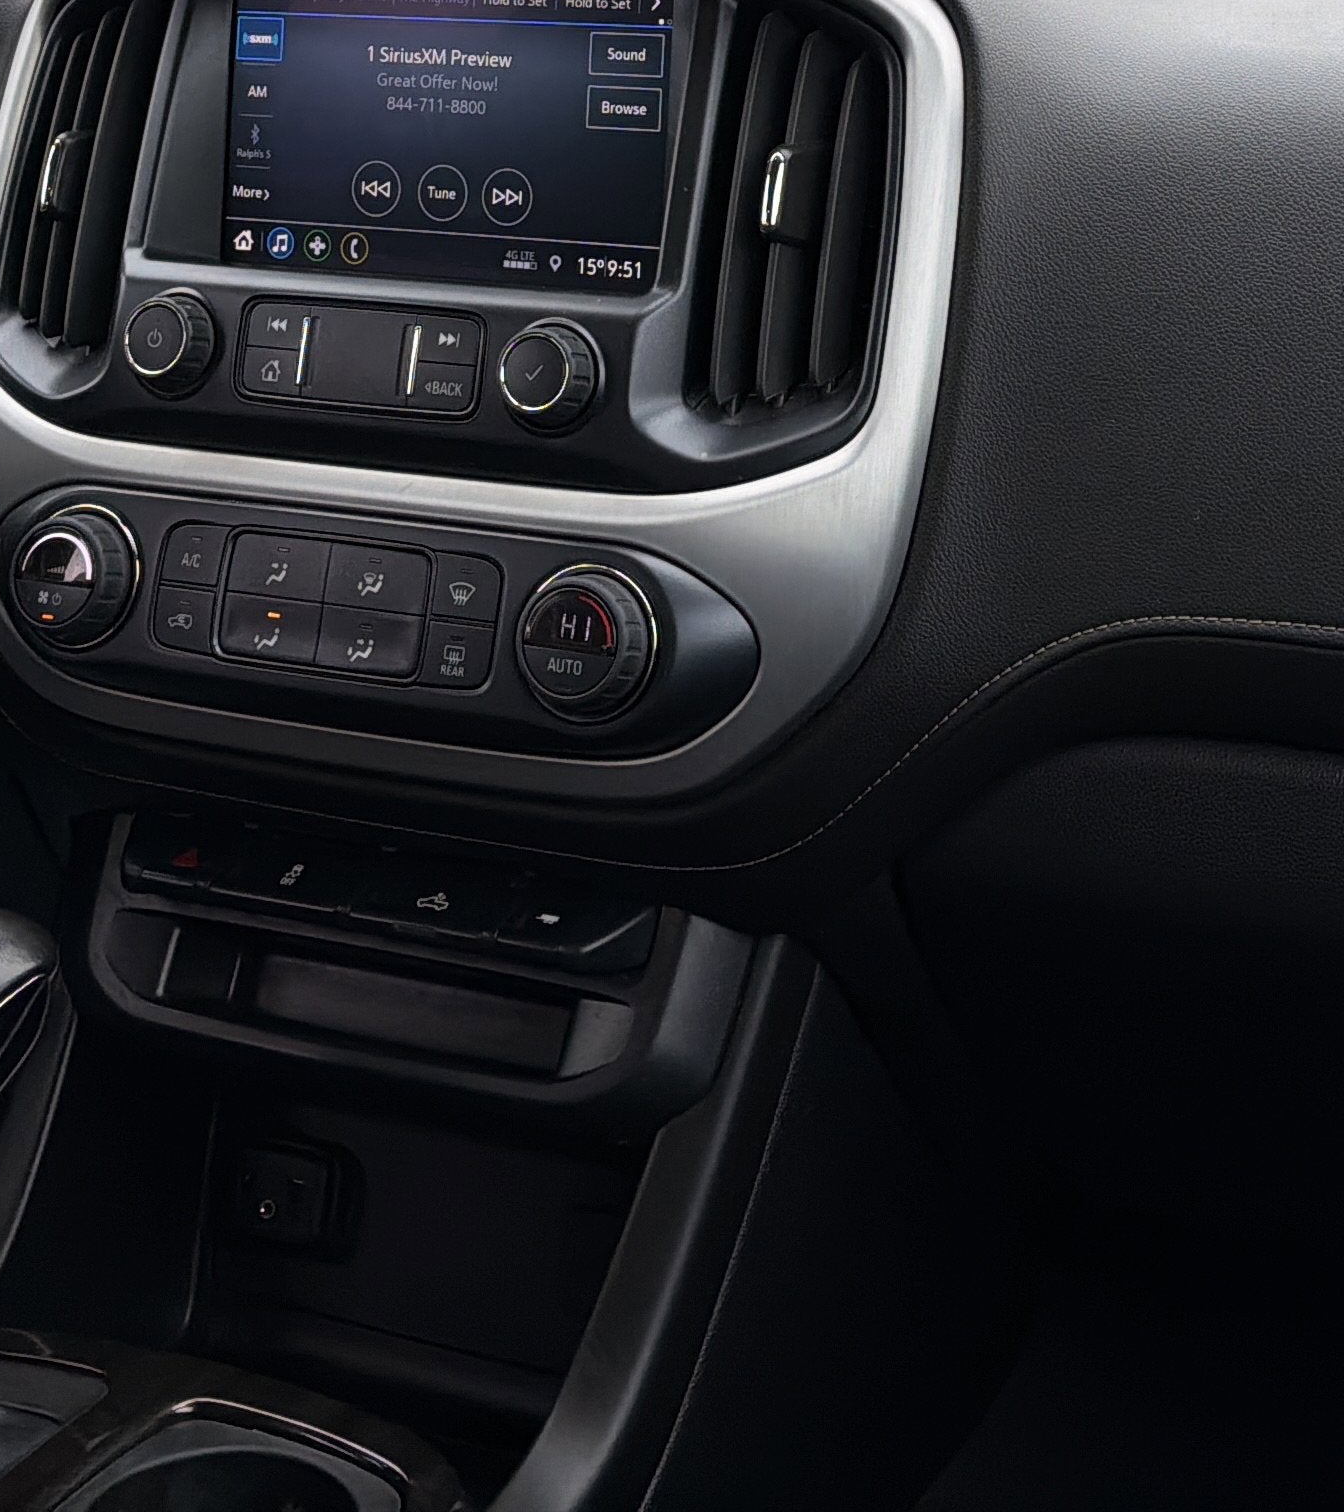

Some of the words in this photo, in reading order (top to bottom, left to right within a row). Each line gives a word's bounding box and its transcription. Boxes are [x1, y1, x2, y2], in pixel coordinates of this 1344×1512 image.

[367, 45, 374, 62] 1
[379, 46, 447, 65] SiriusXM
[450, 49, 513, 68] Preview
[607, 47, 646, 62] Sound
[376, 72, 416, 88] Great
[419, 73, 457, 90] Offer
[461, 75, 499, 92] Now!
[247, 85, 268, 99] AM
[386, 96, 487, 115] 844-711-8800
[600, 101, 648, 116] Browse
[236, 147, 265, 160] Ralph's
[265, 149, 272, 159] S
[232, 185, 263, 200] More
[426, 186, 457, 201] Tune
[505, 250, 519, 260] 4G
[520, 251, 536, 261] LTE
[607, 260, 643, 279] 9:51
[431, 380, 463, 398] BACK
[180, 553, 202, 569] A/C
[439, 664, 465, 678] REAR
[547, 657, 584, 676] AUTO
